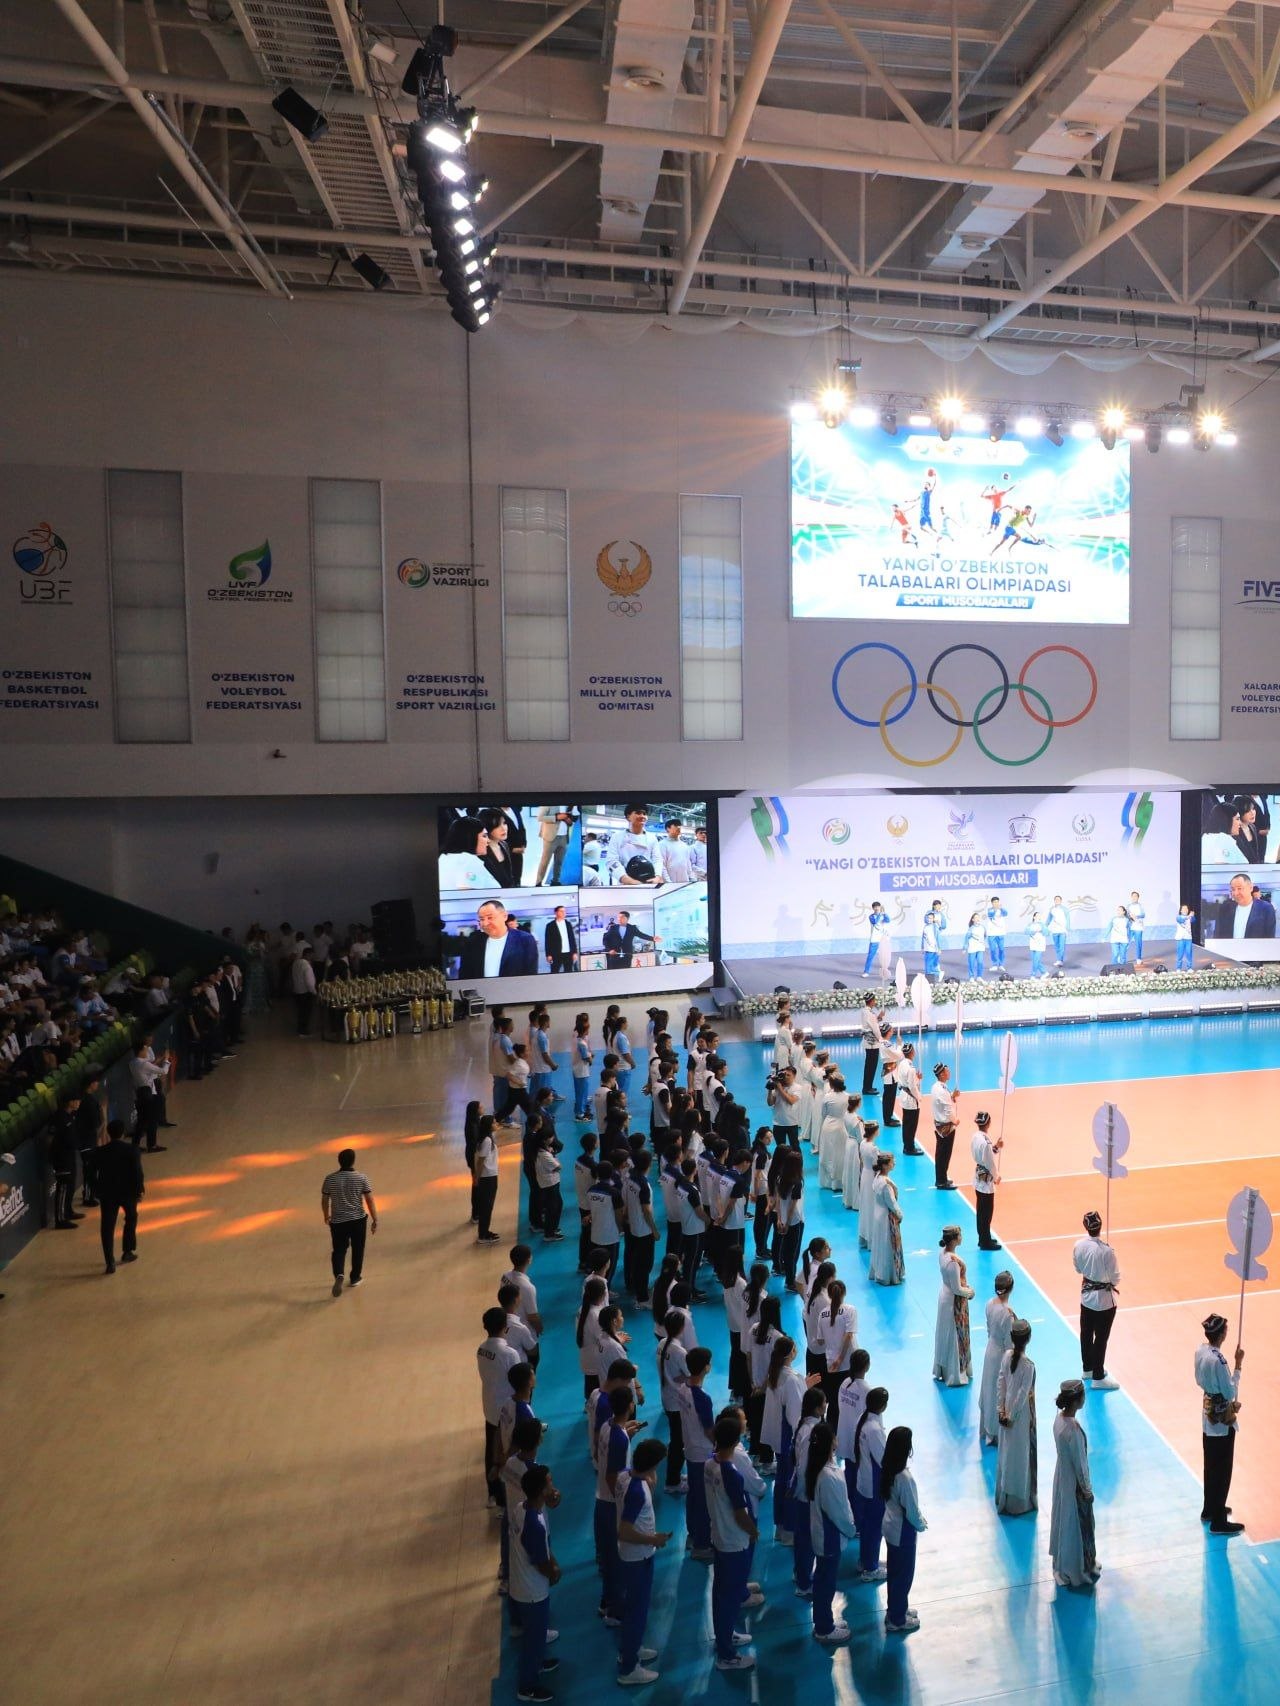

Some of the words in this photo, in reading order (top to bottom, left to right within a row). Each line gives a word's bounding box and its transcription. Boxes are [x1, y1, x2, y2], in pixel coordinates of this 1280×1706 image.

[882, 557, 935, 572] YANGI
[941, 558, 1049, 575] O'ZBEKISTON
[432, 567, 471, 577] SPORT
[432, 577, 489, 587] VAZIRLIGI
[858, 573, 961, 590] TALABALARI
[966, 577, 1071, 593] OLIMPIADASI
[207, 589, 293, 598] O'ZBEKISTON
[903, 595, 940, 606] SPORT
[2, 671, 92, 681] O'ZBEKISTON
[211, 673, 295, 683] O'ZBEKISTON
[406, 674, 485, 684] O'ZBEKISTON
[589, 675, 663, 685] O'ZBEKISTON
[7, 685, 87, 695] BASKETBOL
[221, 686, 287, 696] VOLEYBOL
[403, 688, 489, 698] RESPUBLIKASI
[580, 689, 617, 698] MILLIY
[620, 689, 672, 698] OLIMPIYA
[206, 700, 302, 710] FEDERATSIYASI
[396, 701, 436, 711] SPORT
[438, 702, 496, 711] VAZIRLIGI
[598, 702, 655, 711] QO'MITASI
[857, 856, 940, 869] O'ZBEKISTON
[943, 854, 1020, 867] TALABALARI
[892, 874, 932, 888] SPORT
[935, 872, 1029, 887] MUSOBAQALARI
